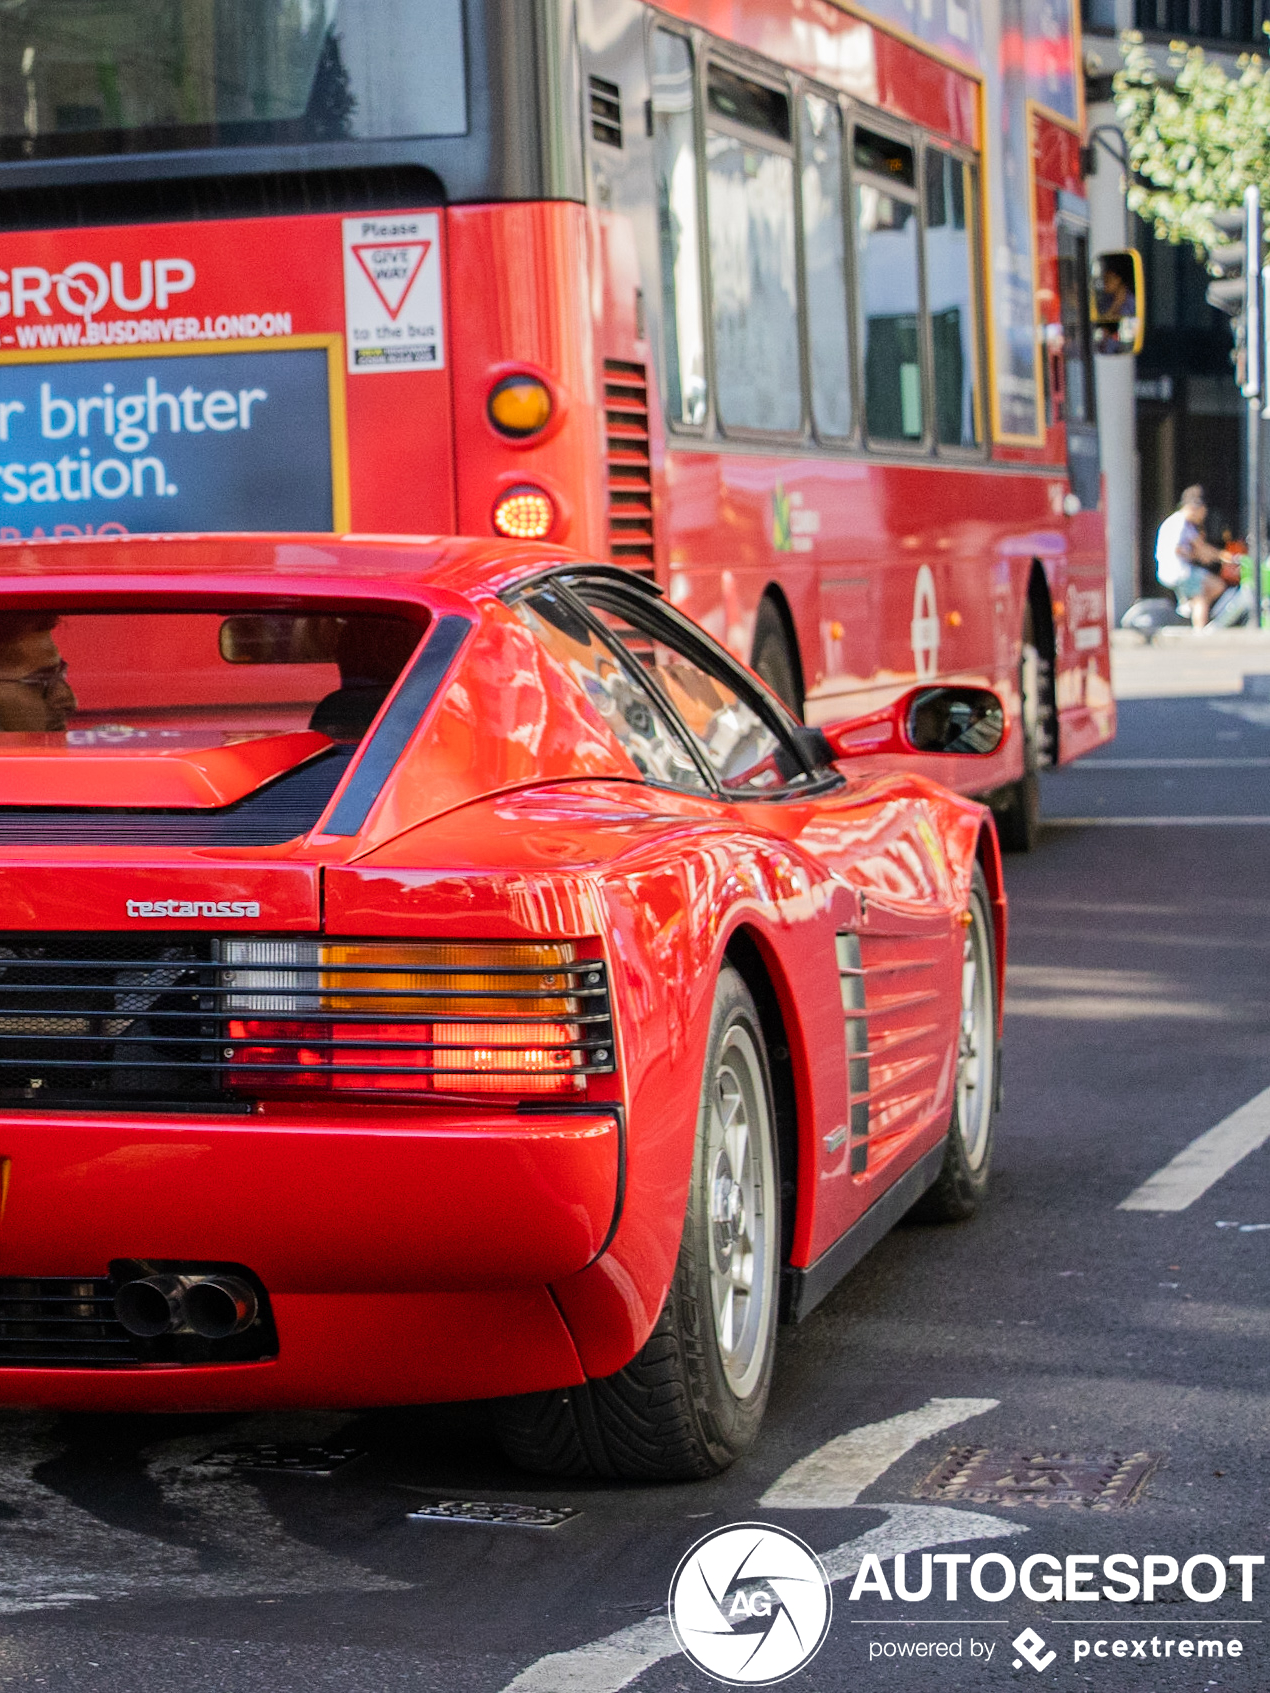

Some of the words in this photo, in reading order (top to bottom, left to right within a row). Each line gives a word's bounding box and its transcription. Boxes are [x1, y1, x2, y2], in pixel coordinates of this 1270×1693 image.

[361, 222, 419, 237] Please
[371, 250, 409, 264] GIVE
[375, 267, 408, 280] WAY
[16, 312, 292, 349] WWW.BUSDRIVER.LONDON
[353, 327, 369, 340] to
[375, 325, 403, 339] the
[407, 323, 436, 338] bus
[39, 376, 269, 453] brighter
[126, 899, 260, 918] testarossa
